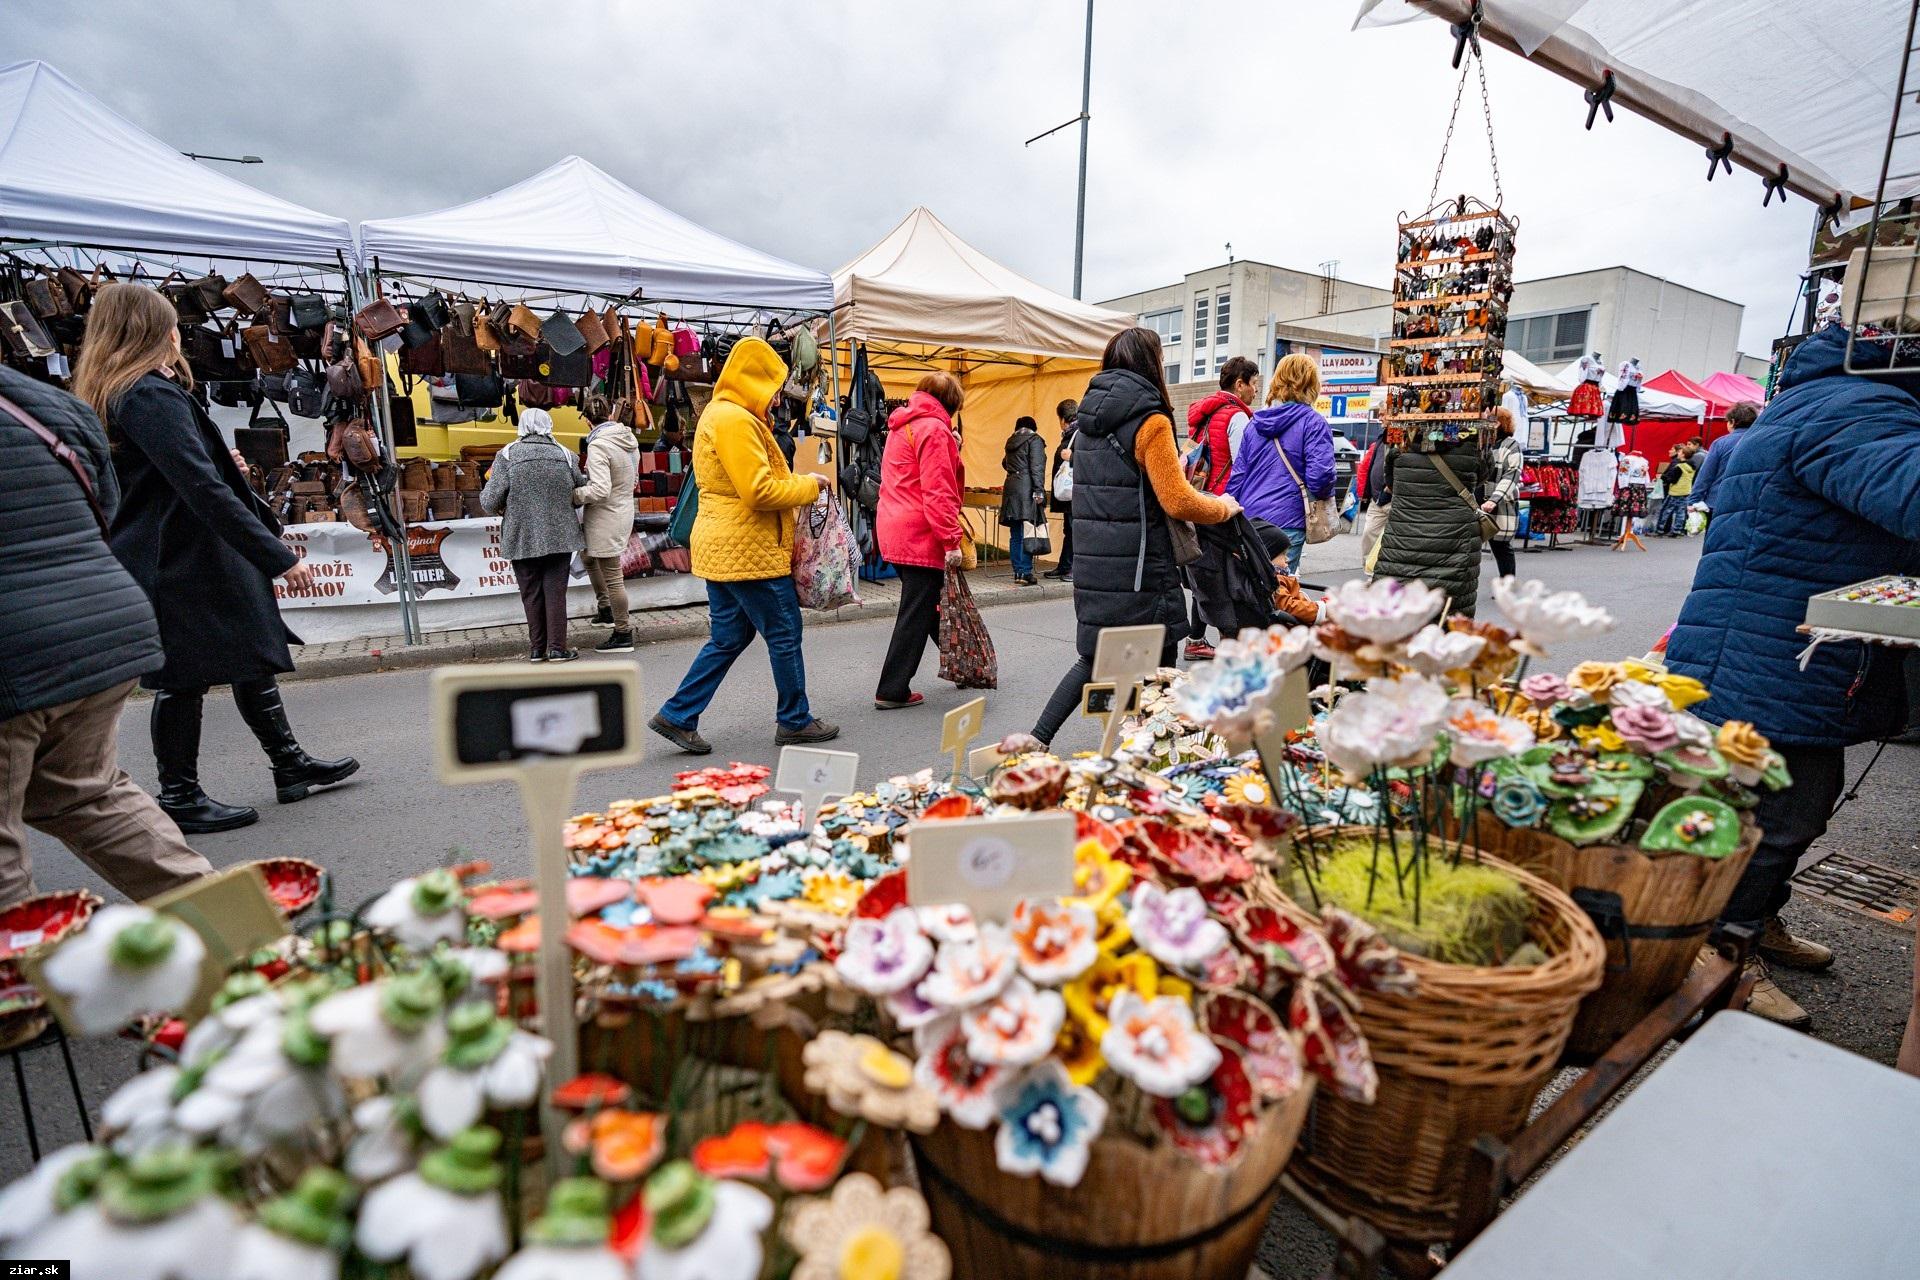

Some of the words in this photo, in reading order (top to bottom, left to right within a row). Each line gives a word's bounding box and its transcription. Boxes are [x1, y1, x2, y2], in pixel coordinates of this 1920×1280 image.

[389, 569, 445, 584] LTHER
[479, 572, 518, 588] PEŇA
[274, 582, 345, 599] ROBKOV
